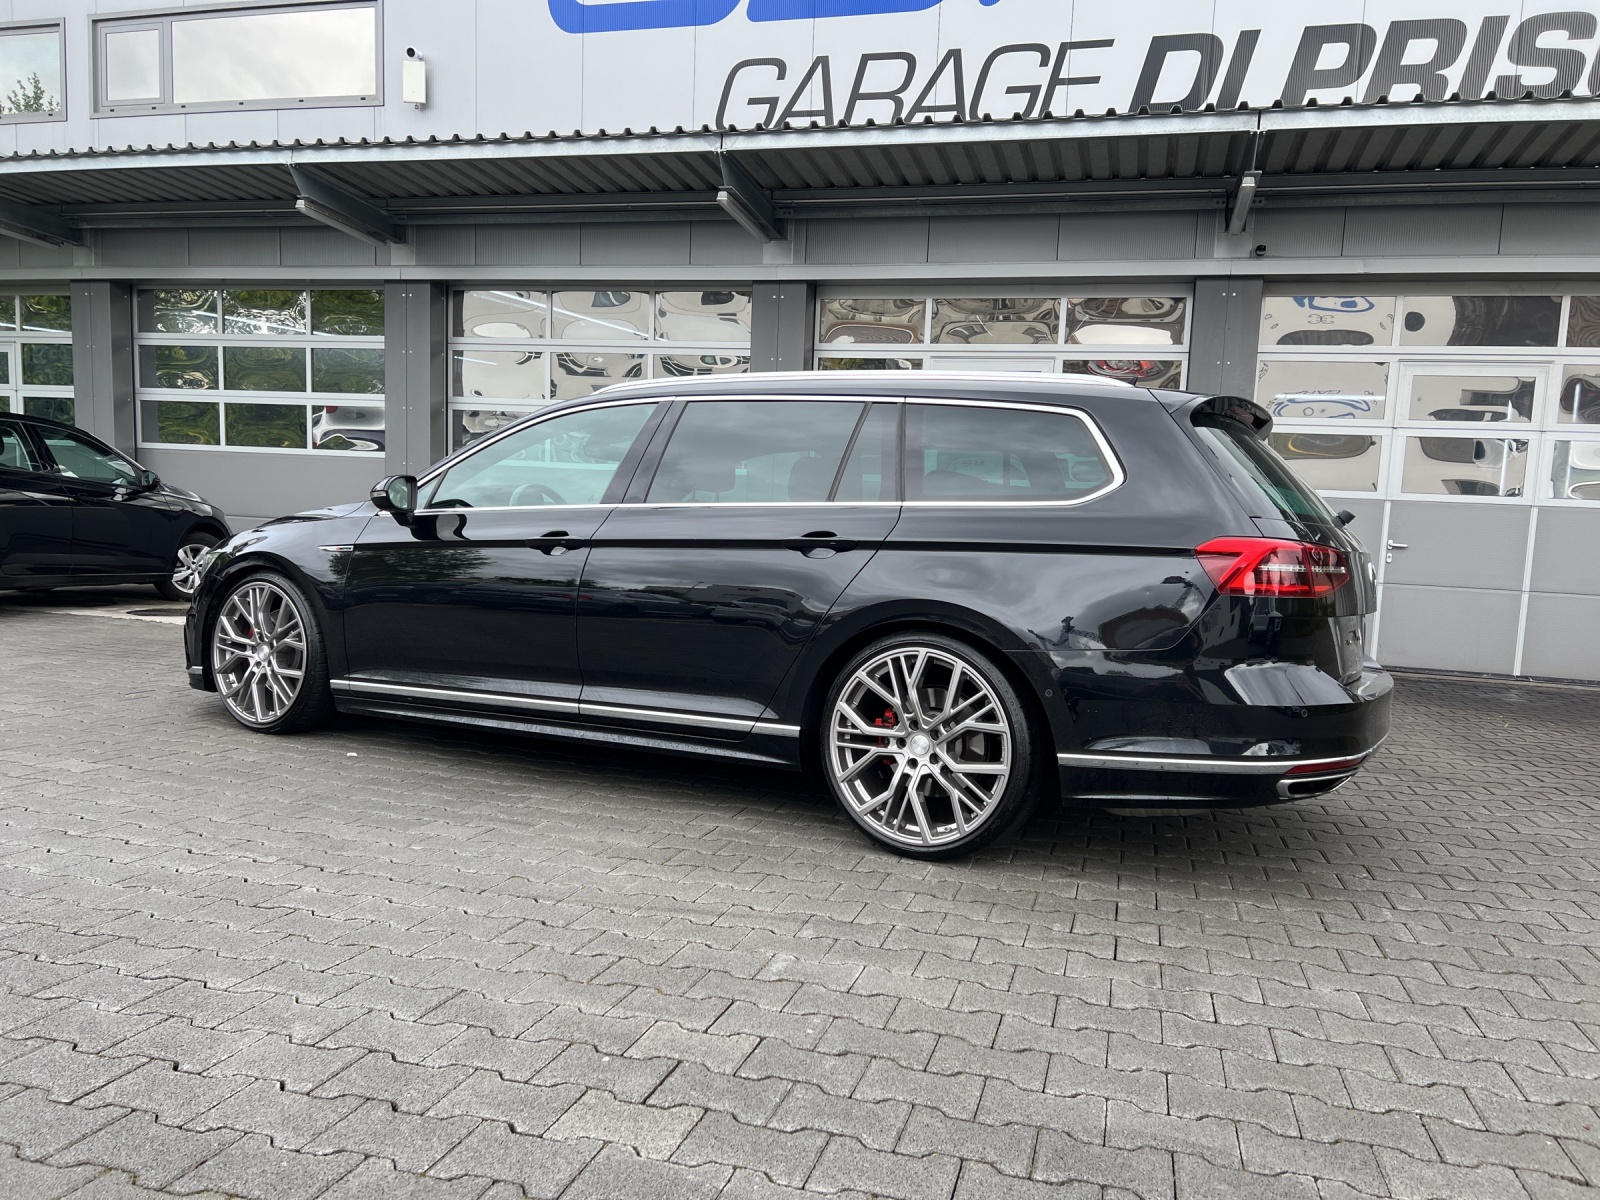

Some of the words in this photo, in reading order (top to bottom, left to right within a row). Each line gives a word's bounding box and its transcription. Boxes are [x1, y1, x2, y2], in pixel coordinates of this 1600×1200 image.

[715, 39, 1115, 130] GARAGE
[1128, 29, 1261, 113] DI
[1280, 11, 1600, 106] PRIS
